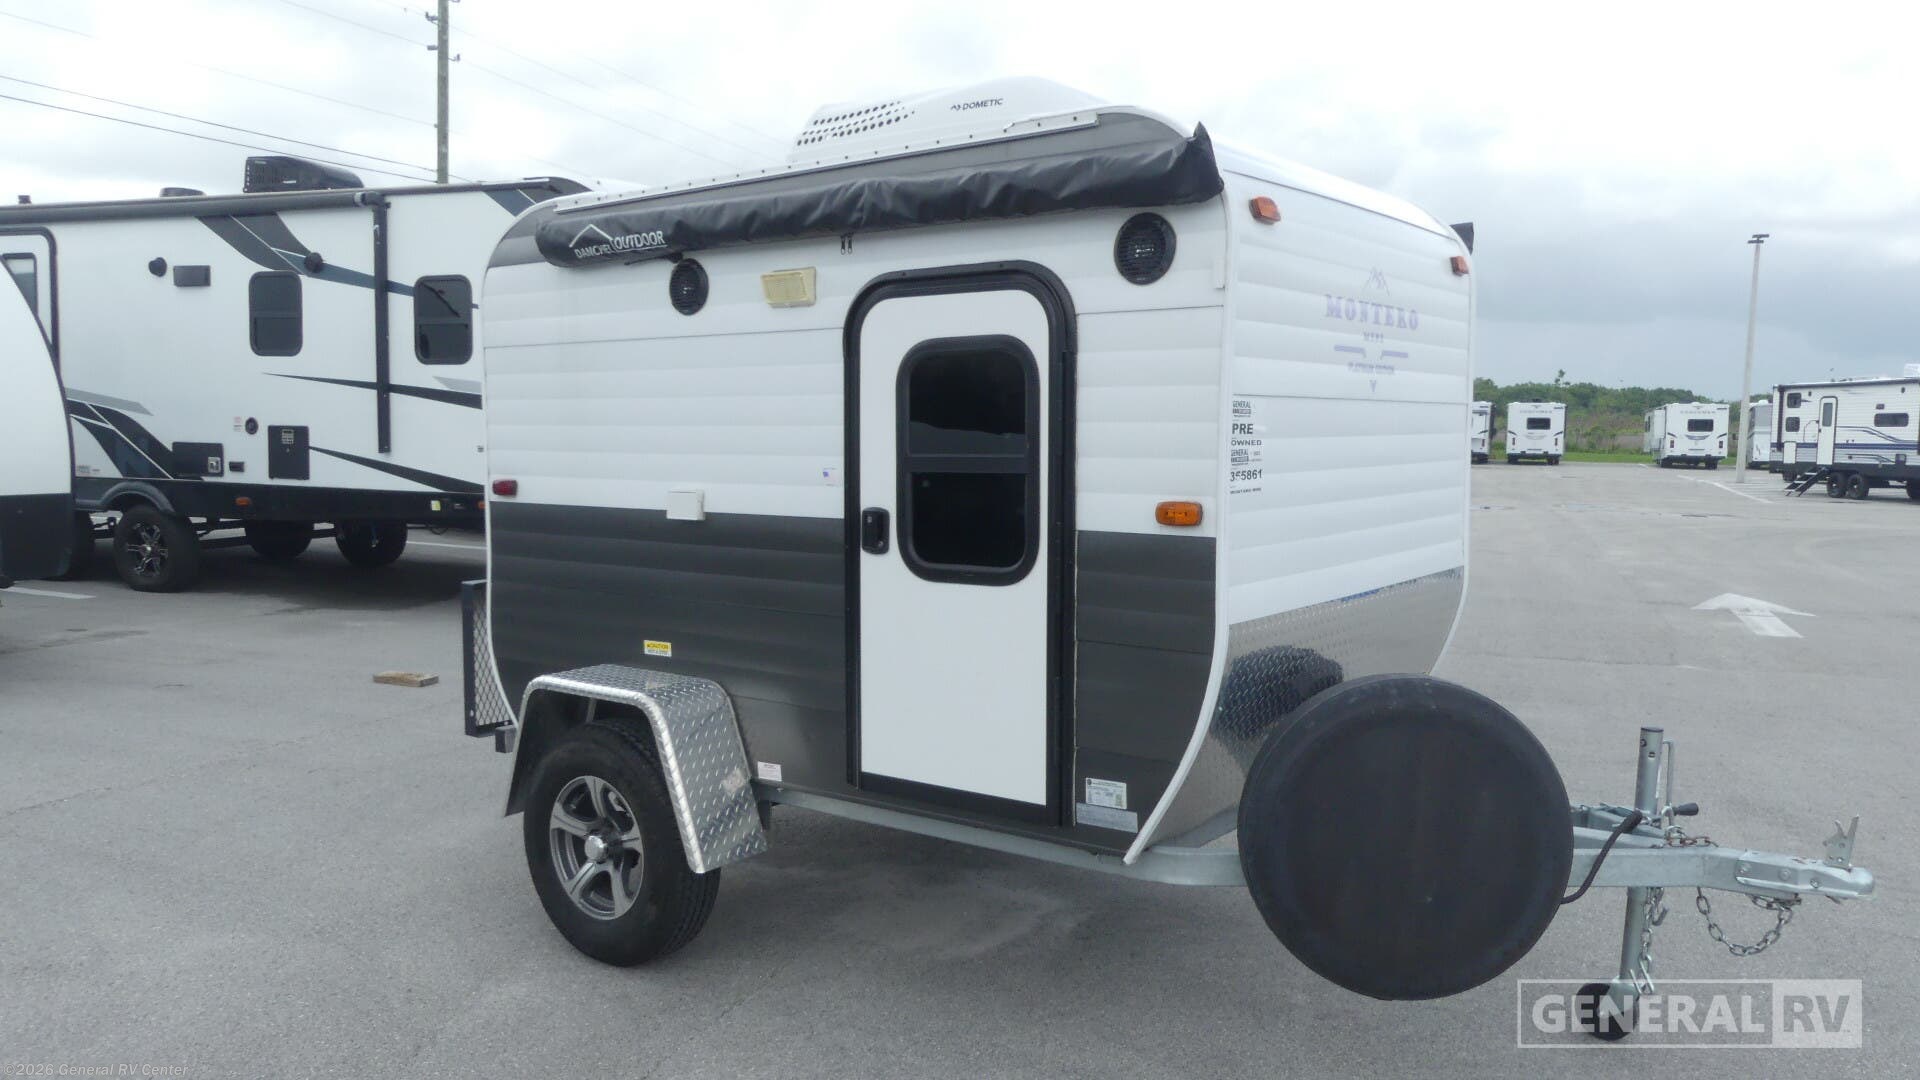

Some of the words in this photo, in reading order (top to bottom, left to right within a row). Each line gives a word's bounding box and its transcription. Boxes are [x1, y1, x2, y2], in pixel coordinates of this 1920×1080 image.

[962, 98, 1004, 111] DOMETIC
[614, 230, 666, 250] OUTDOOR
[1231, 423, 1254, 435] PRE
[1230, 439, 1262, 447] OWNED
